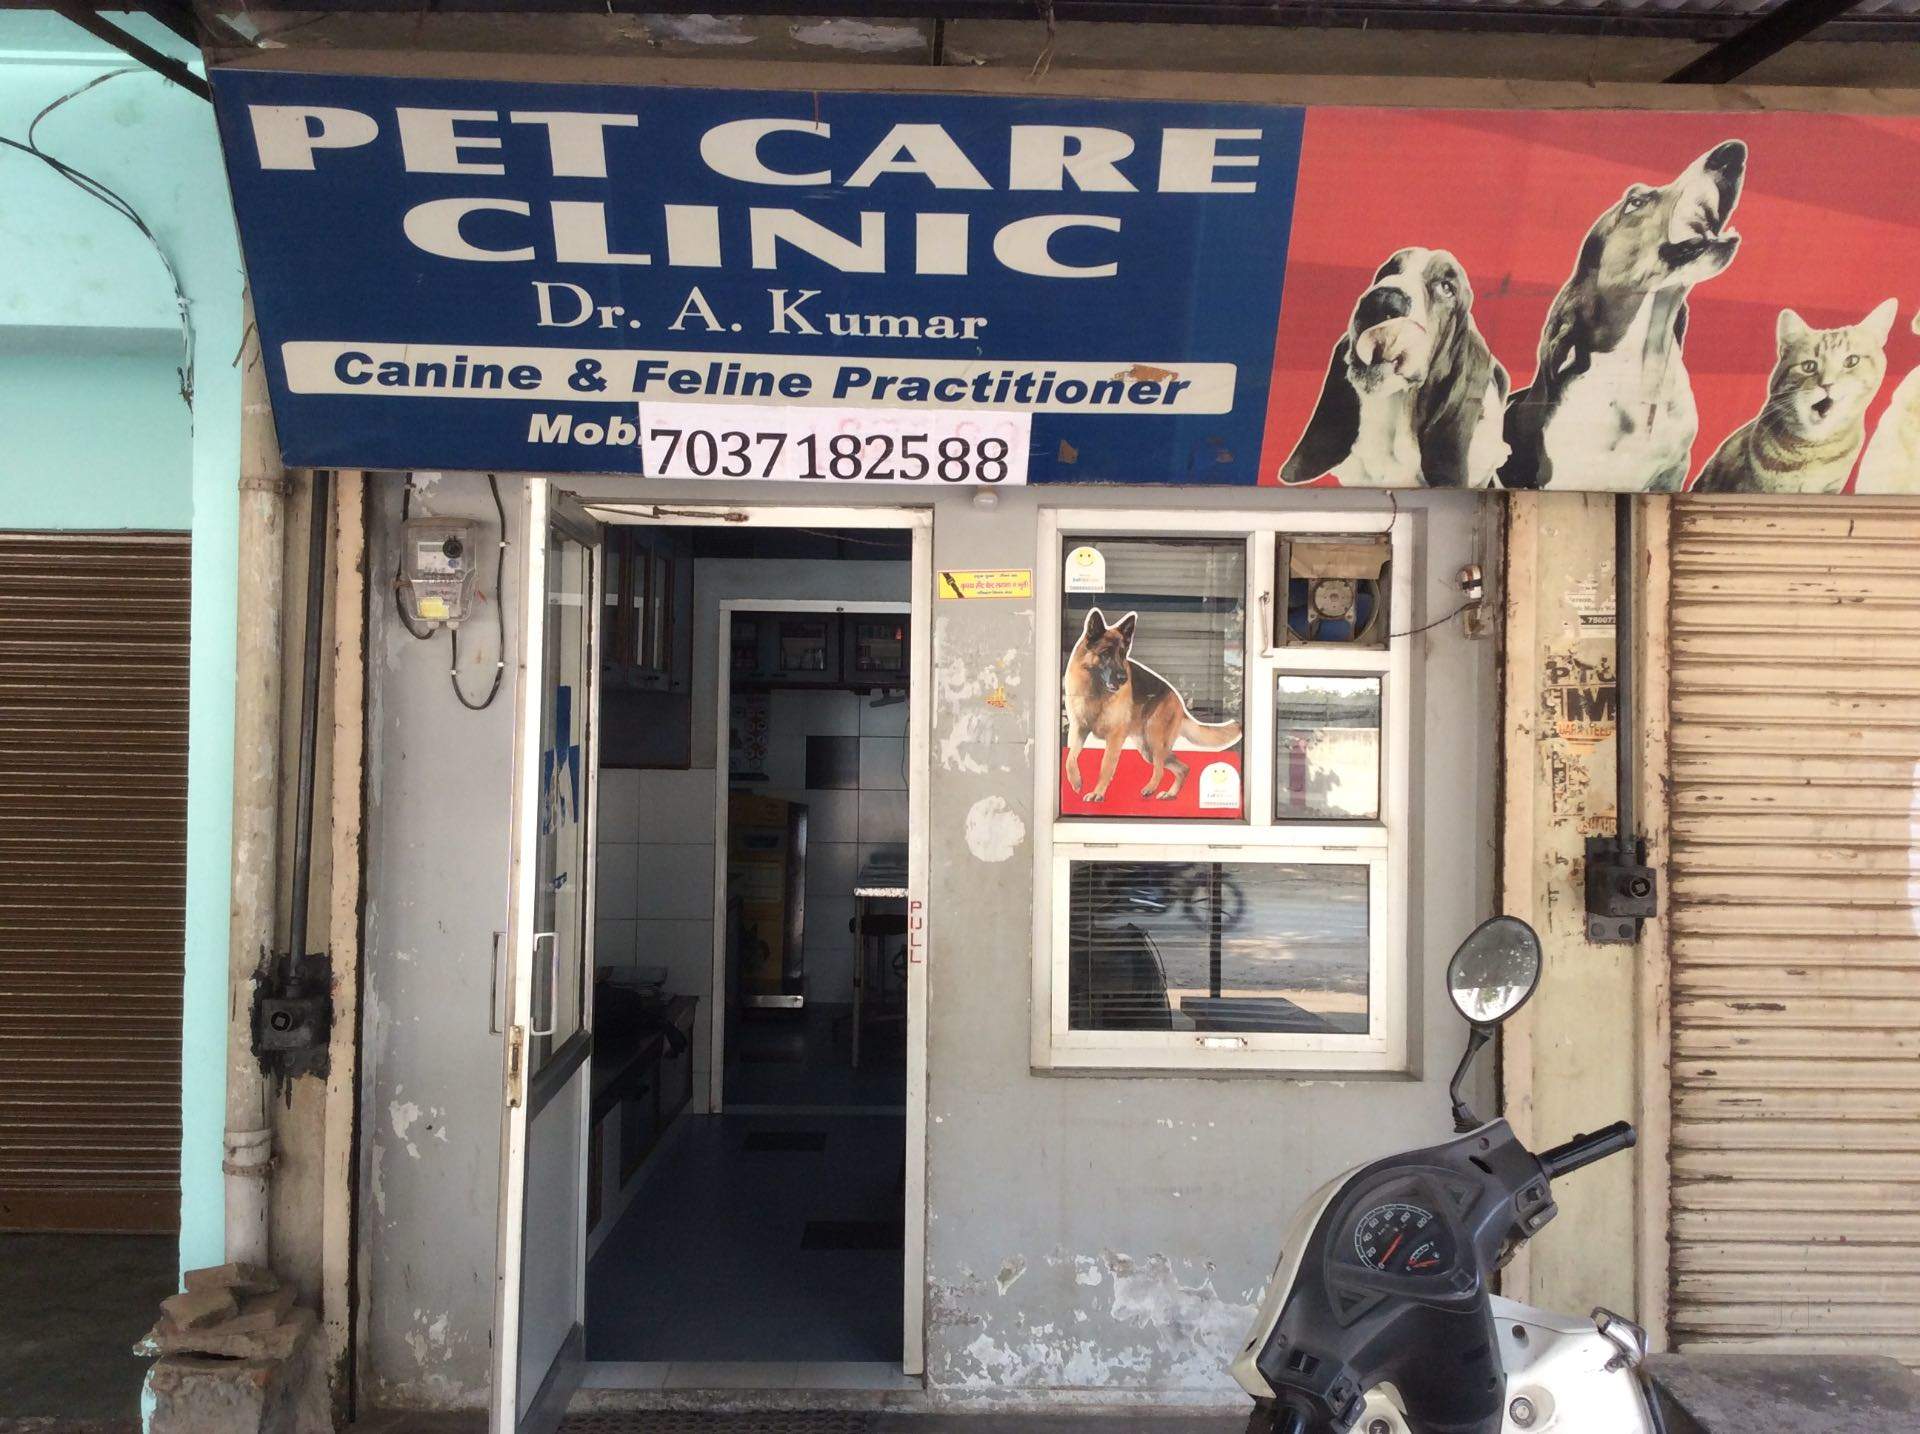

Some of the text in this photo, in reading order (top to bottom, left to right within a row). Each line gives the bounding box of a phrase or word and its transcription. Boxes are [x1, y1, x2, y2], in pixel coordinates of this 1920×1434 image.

[248, 104, 1263, 194] PET CARE
[403, 197, 1121, 279] CLINIC
[531, 281, 988, 340] Dr. A. Kumar
[333, 351, 1192, 406] Canine & Feline Practitioner
[650, 428, 1010, 483] 7037182588
[910, 901, 922, 963] PULL
